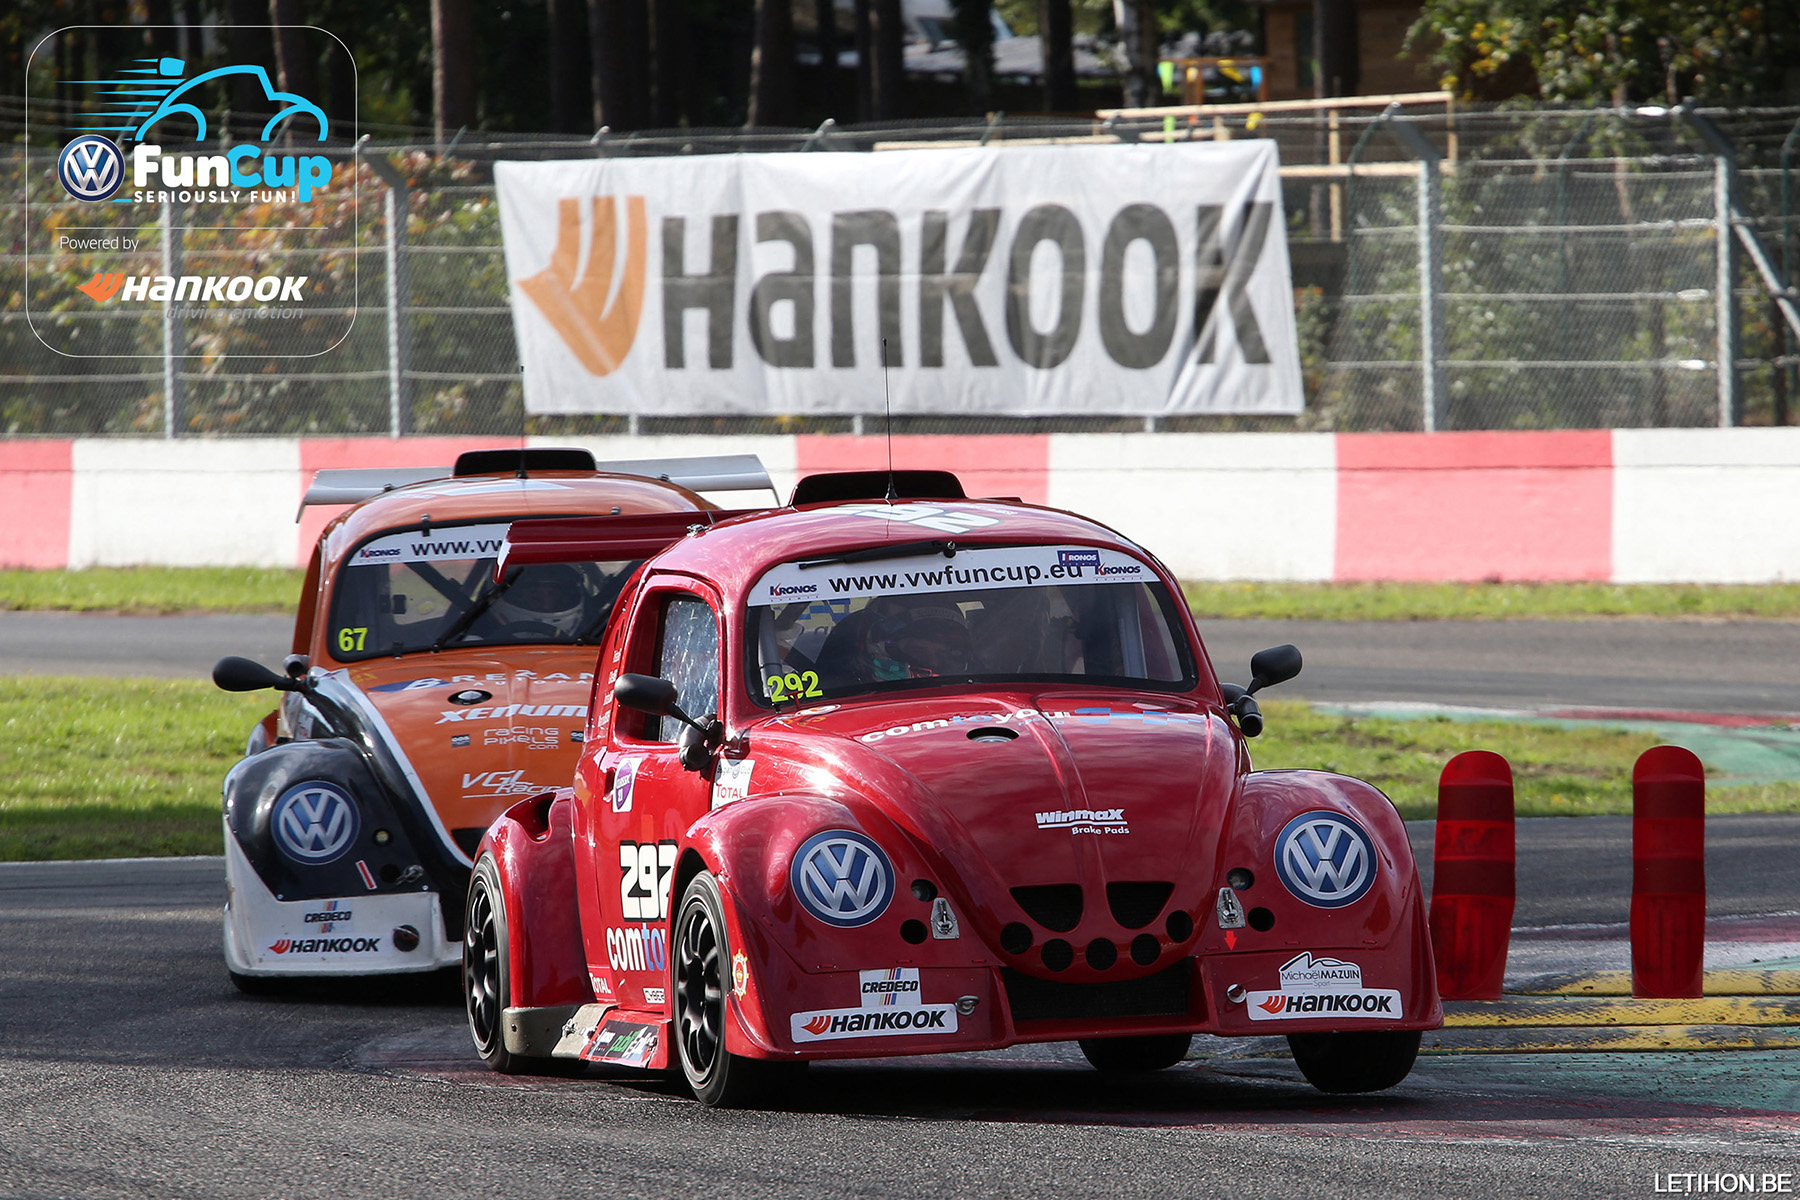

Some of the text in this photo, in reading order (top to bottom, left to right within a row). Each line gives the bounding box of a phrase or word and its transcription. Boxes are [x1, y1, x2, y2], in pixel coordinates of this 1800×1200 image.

[412, 540, 502, 556] www.vw
[1062, 553, 1097, 562] KRONOS
[1094, 563, 1140, 575] KRONOS
[829, 563, 1083, 593] www.vwfuncup.eu
[770, 583, 817, 596] KRONOS
[338, 627, 368, 652] 67
[473, 677, 589, 686] AUTOPA
[767, 671, 823, 702] 292
[462, 770, 534, 788] VGL
[716, 784, 744, 798] TOTAL
[1072, 825, 1130, 835] Brake Pads
[304, 911, 352, 923] CREDECO
[607, 922, 665, 971] comto
[862, 980, 918, 993] CREDECO
[1313, 980, 1330, 988] Sport
